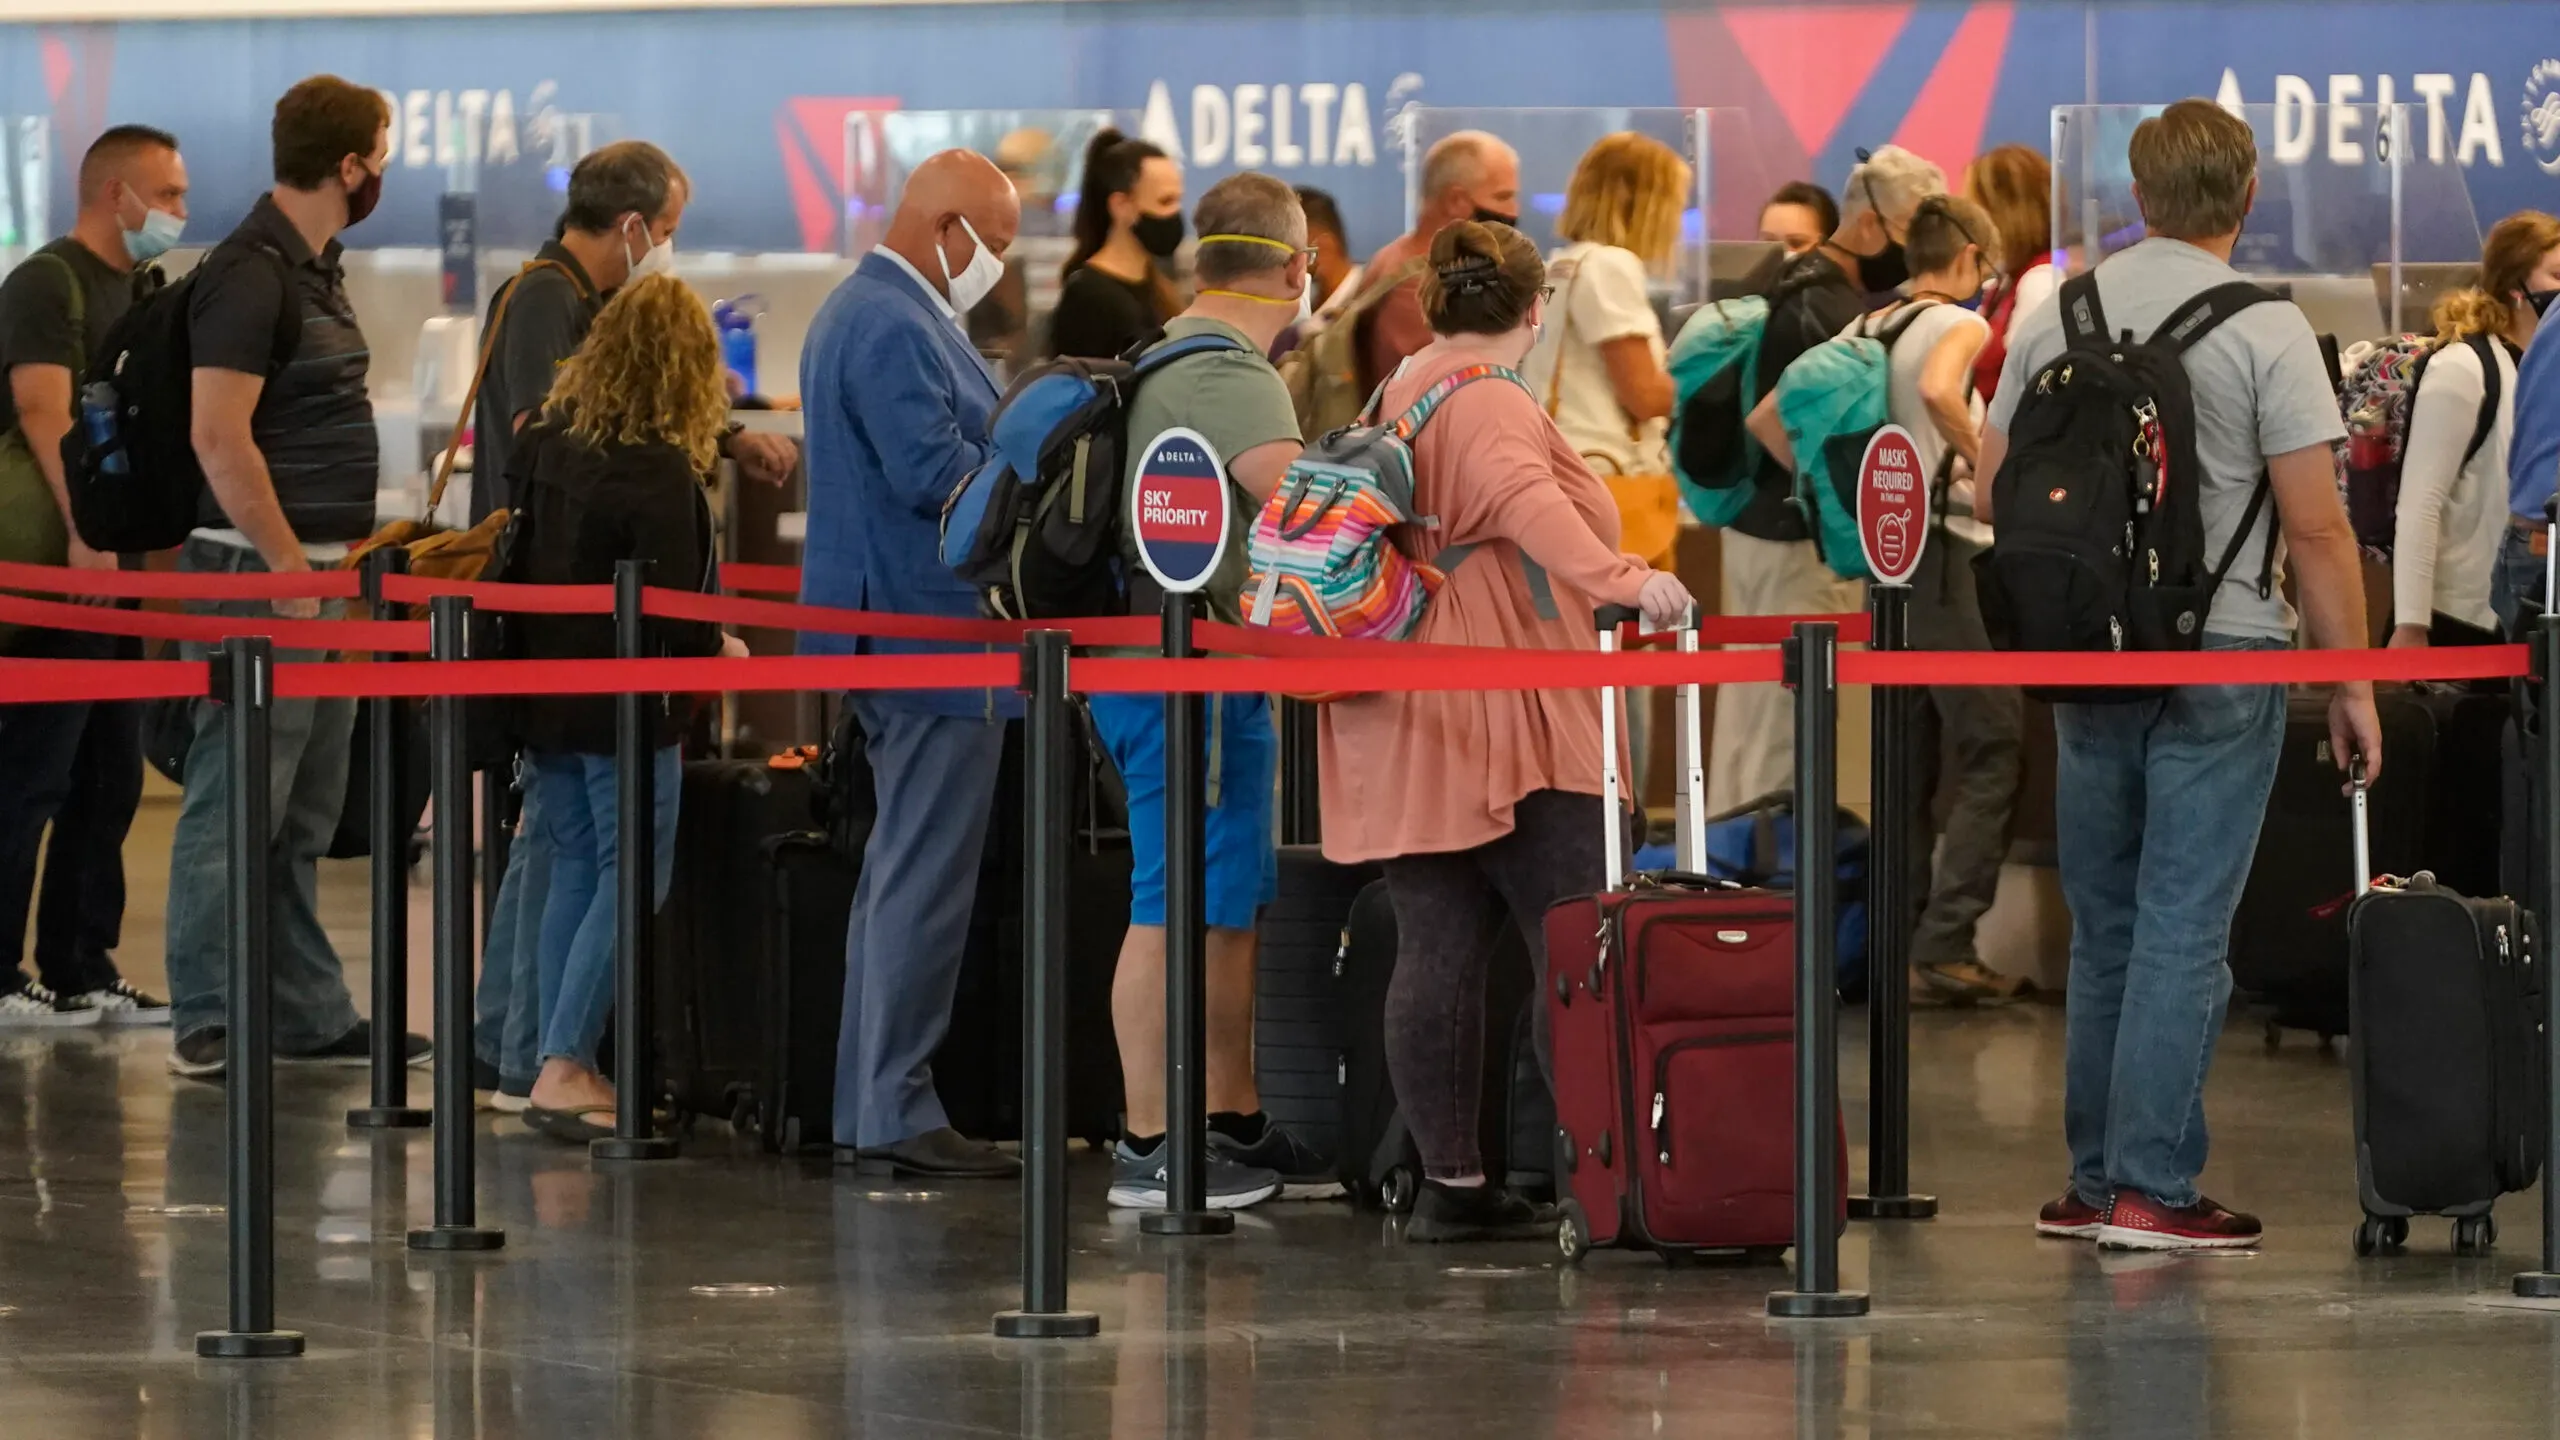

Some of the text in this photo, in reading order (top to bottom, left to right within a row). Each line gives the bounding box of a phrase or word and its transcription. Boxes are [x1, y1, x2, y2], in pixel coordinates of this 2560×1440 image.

[1190, 81, 1377, 169] DELTA
[2272, 72, 2505, 168] DELTA
[2376, 115, 2395, 163] 6
[1166, 451, 1195, 463] DELTA
[1879, 447, 1908, 468] MASKS
[1872, 469, 1914, 491] REQUIRED
[1144, 489, 1172, 506] SKY
[1144, 507, 1208, 527] PRIORITY
